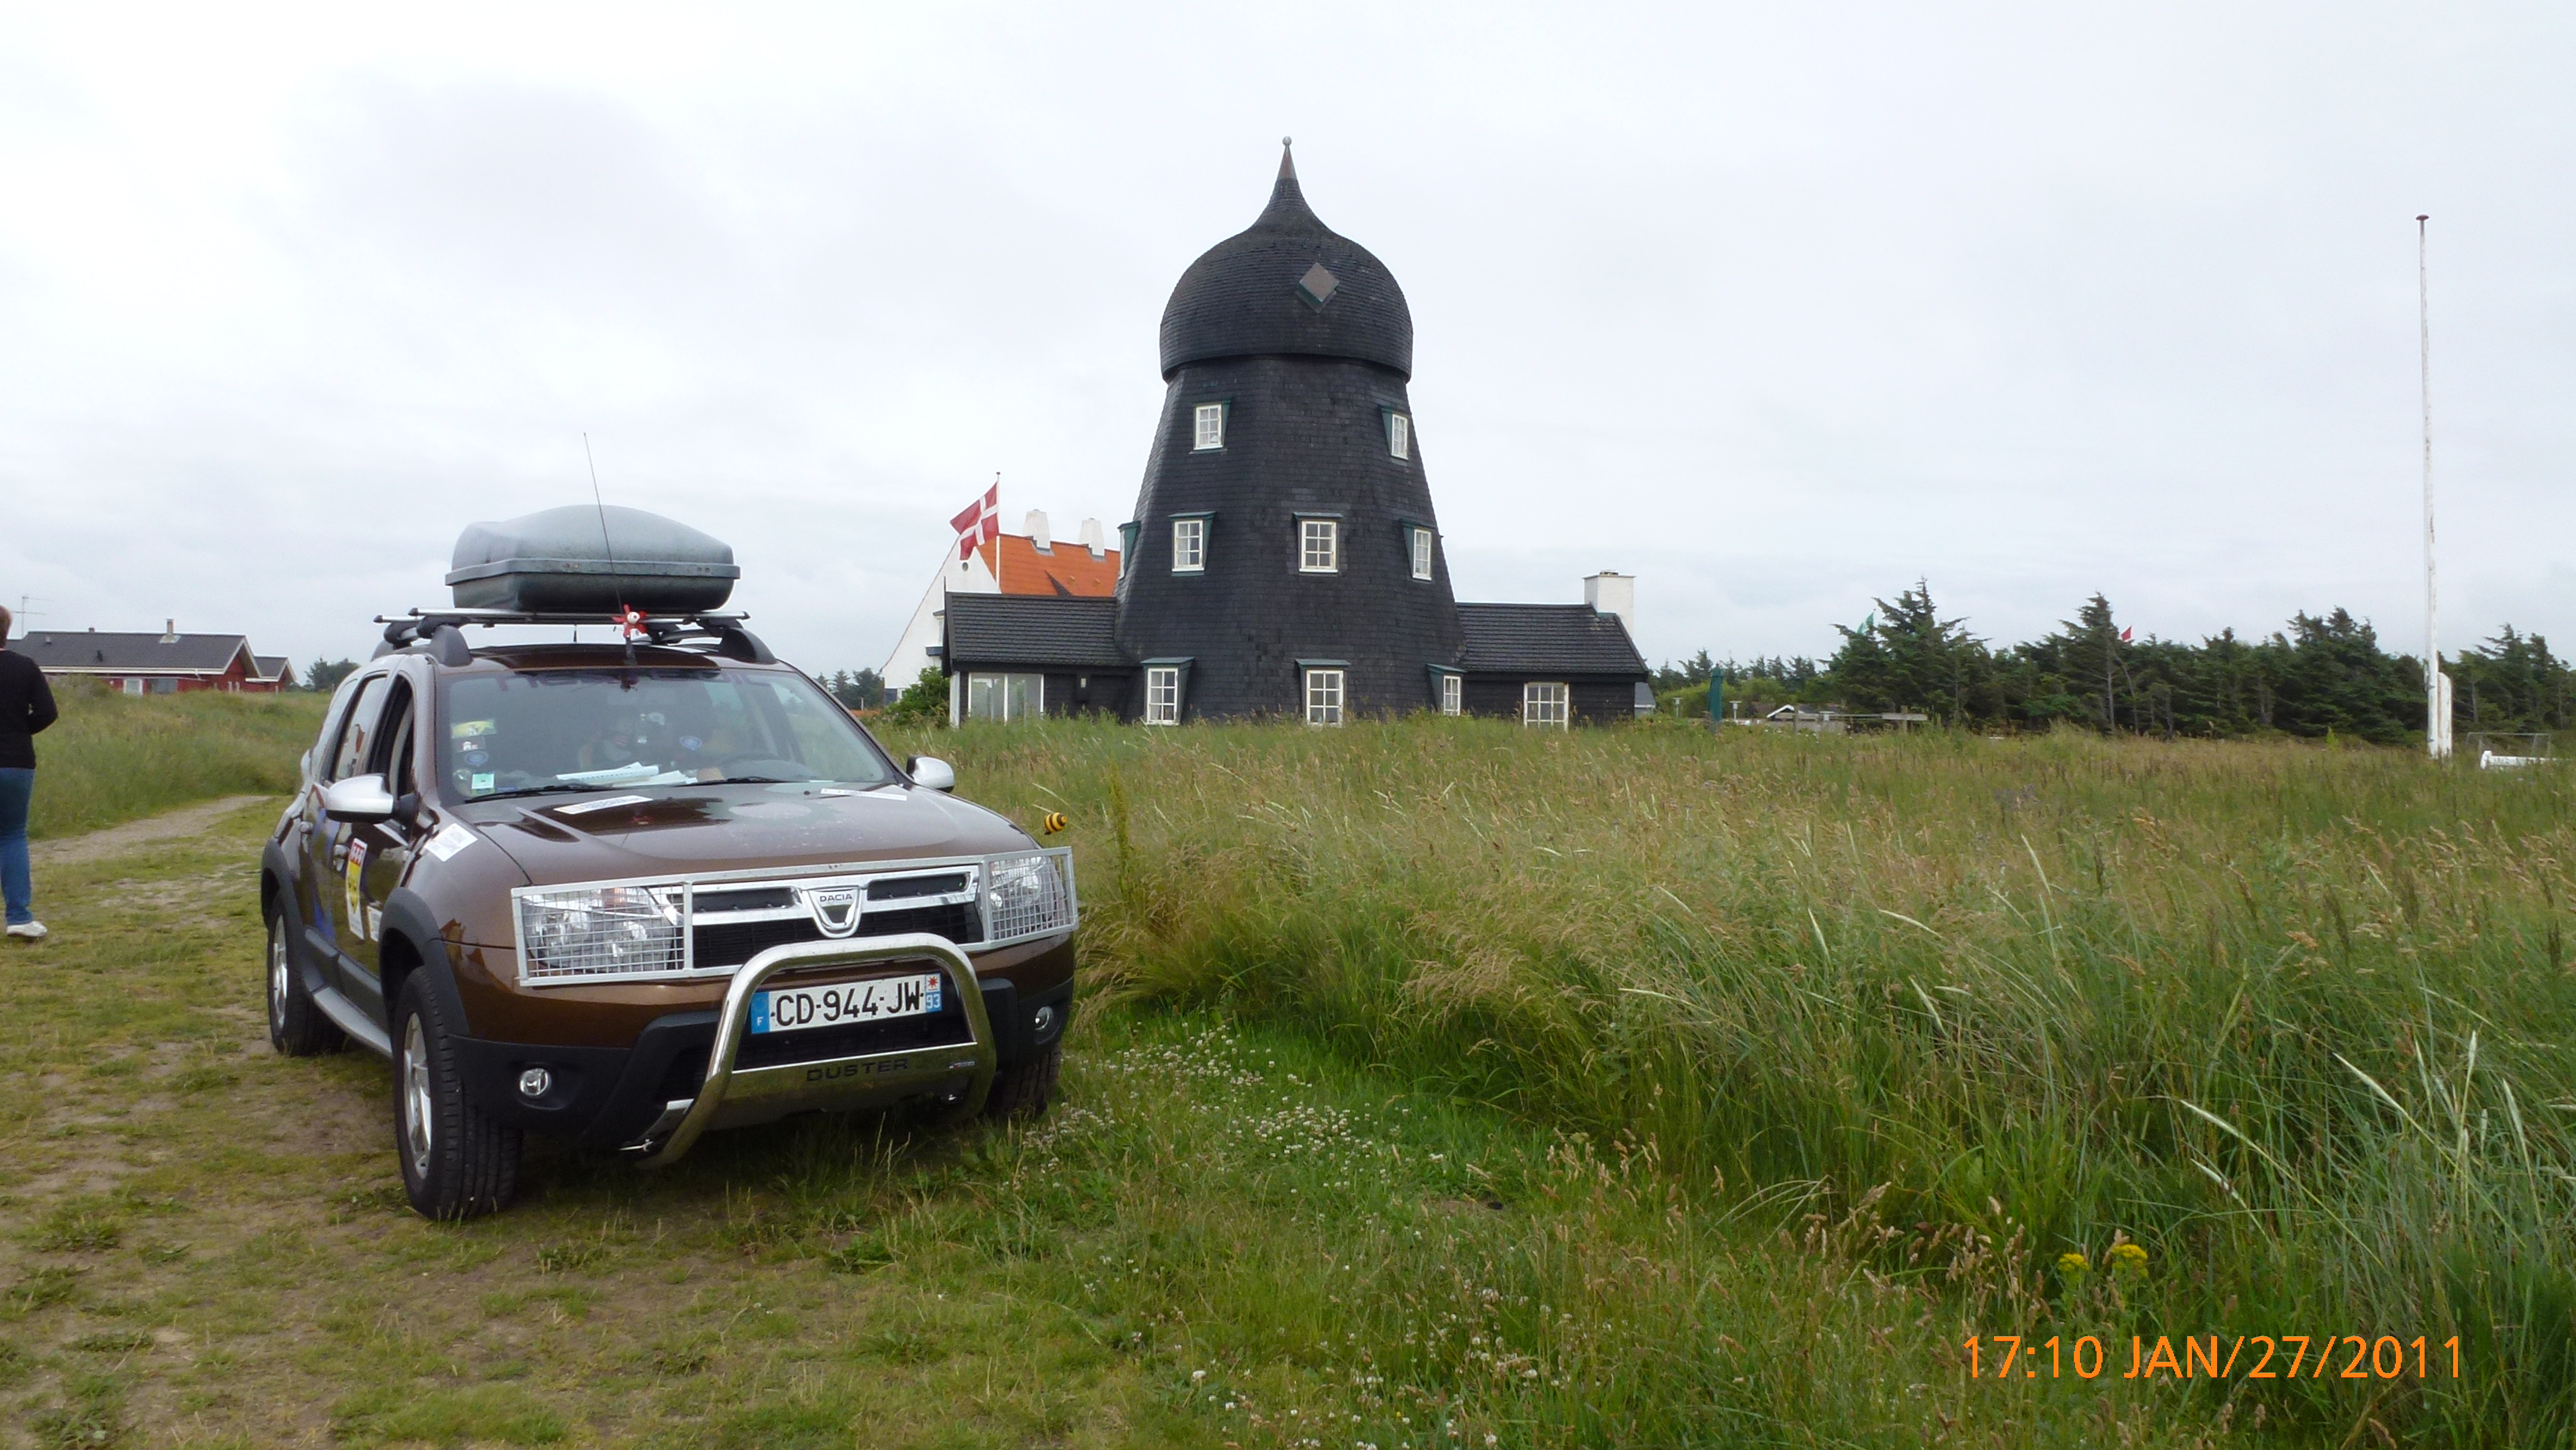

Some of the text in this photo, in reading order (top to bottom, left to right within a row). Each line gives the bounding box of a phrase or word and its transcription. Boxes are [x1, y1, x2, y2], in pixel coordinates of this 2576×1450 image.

[819, 894, 853, 902] DACIA
[926, 993, 940, 1008] 93
[756, 1016, 763, 1026] F
[807, 1058, 909, 1082] DUSTER
